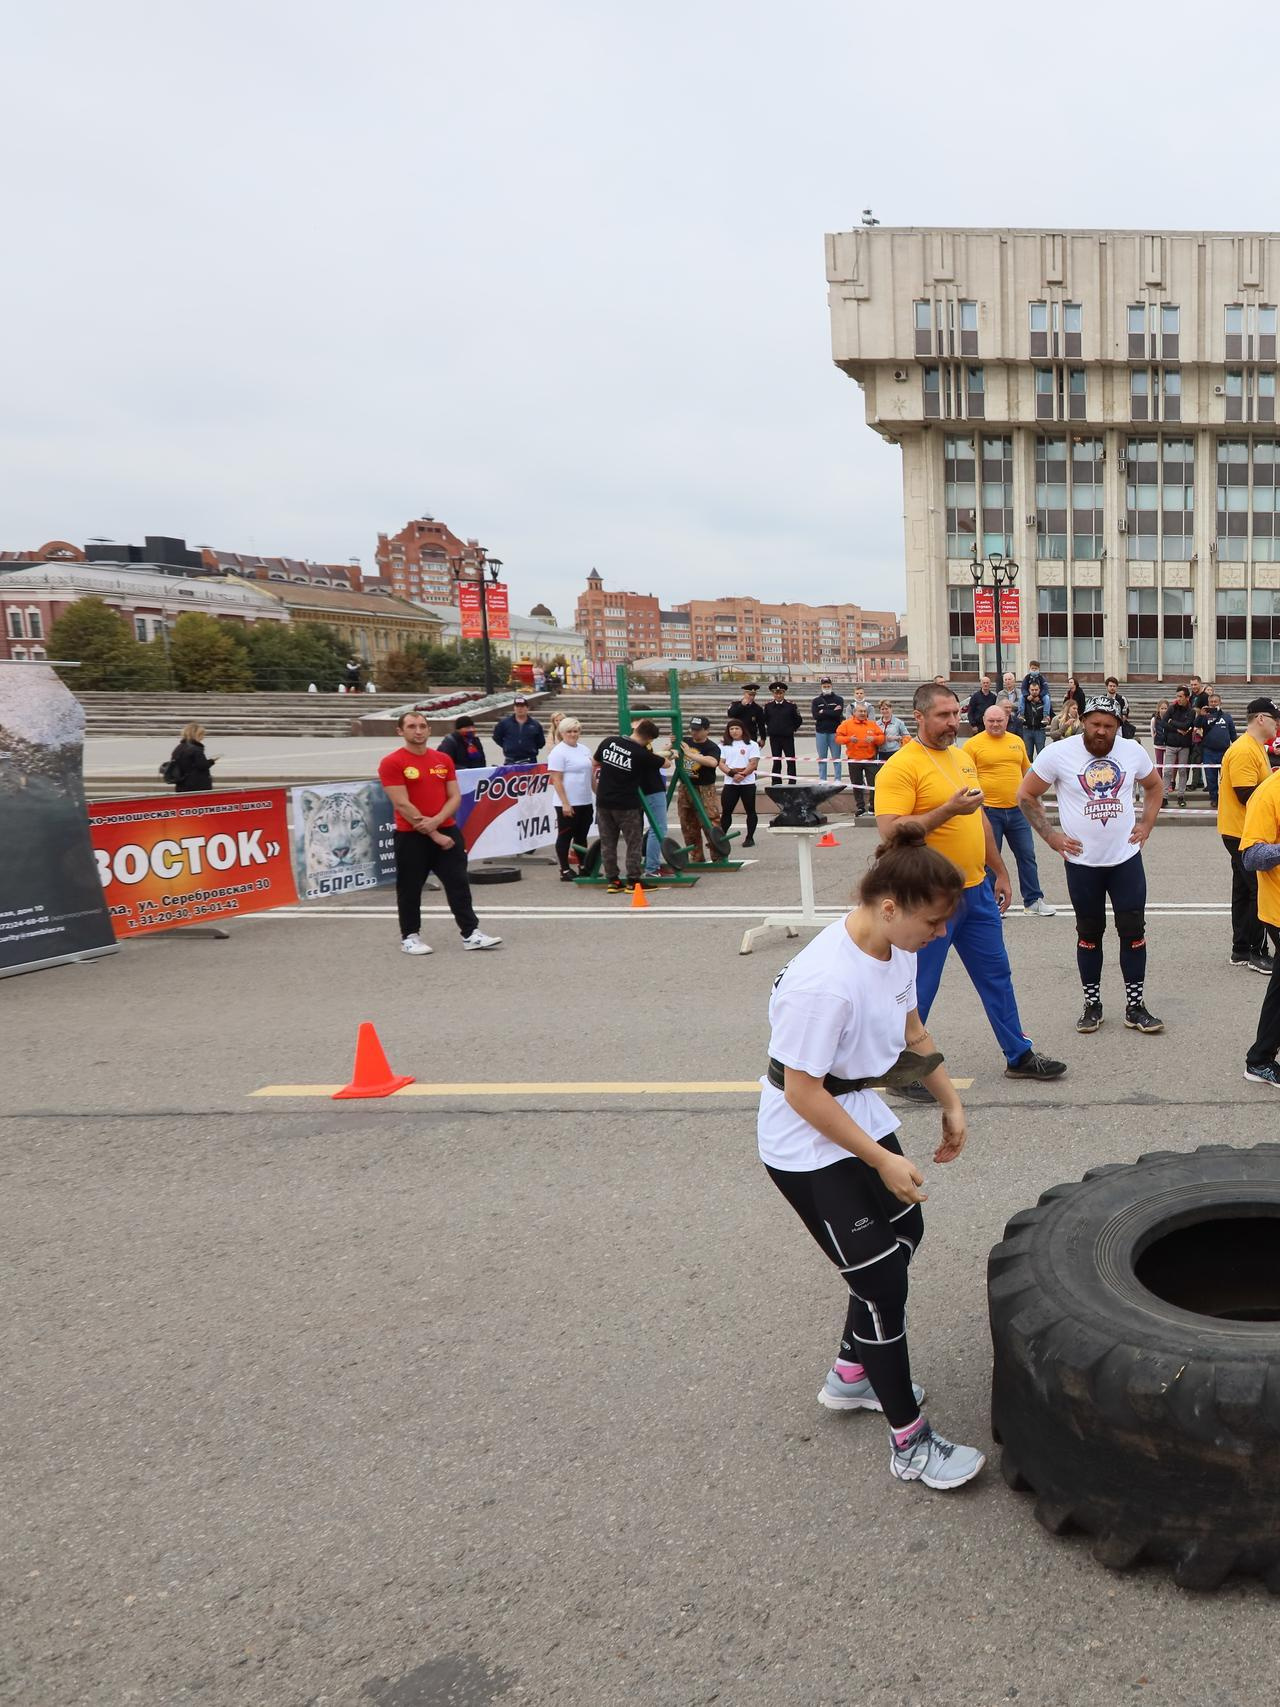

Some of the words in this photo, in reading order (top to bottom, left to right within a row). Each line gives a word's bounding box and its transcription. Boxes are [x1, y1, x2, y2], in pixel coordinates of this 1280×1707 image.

[602, 748, 632, 769] СИЛА
[474, 774, 550, 802] РОССИЯ
[179, 804, 239, 818] спортивная
[241, 800, 273, 812] школа
[137, 901, 158, 914] ул.
[162, 884, 253, 907] Серебровская
[256, 878, 270, 891] 30
[141, 910, 192, 927] 31-20-30,
[194, 899, 239, 916] 36-01-42
